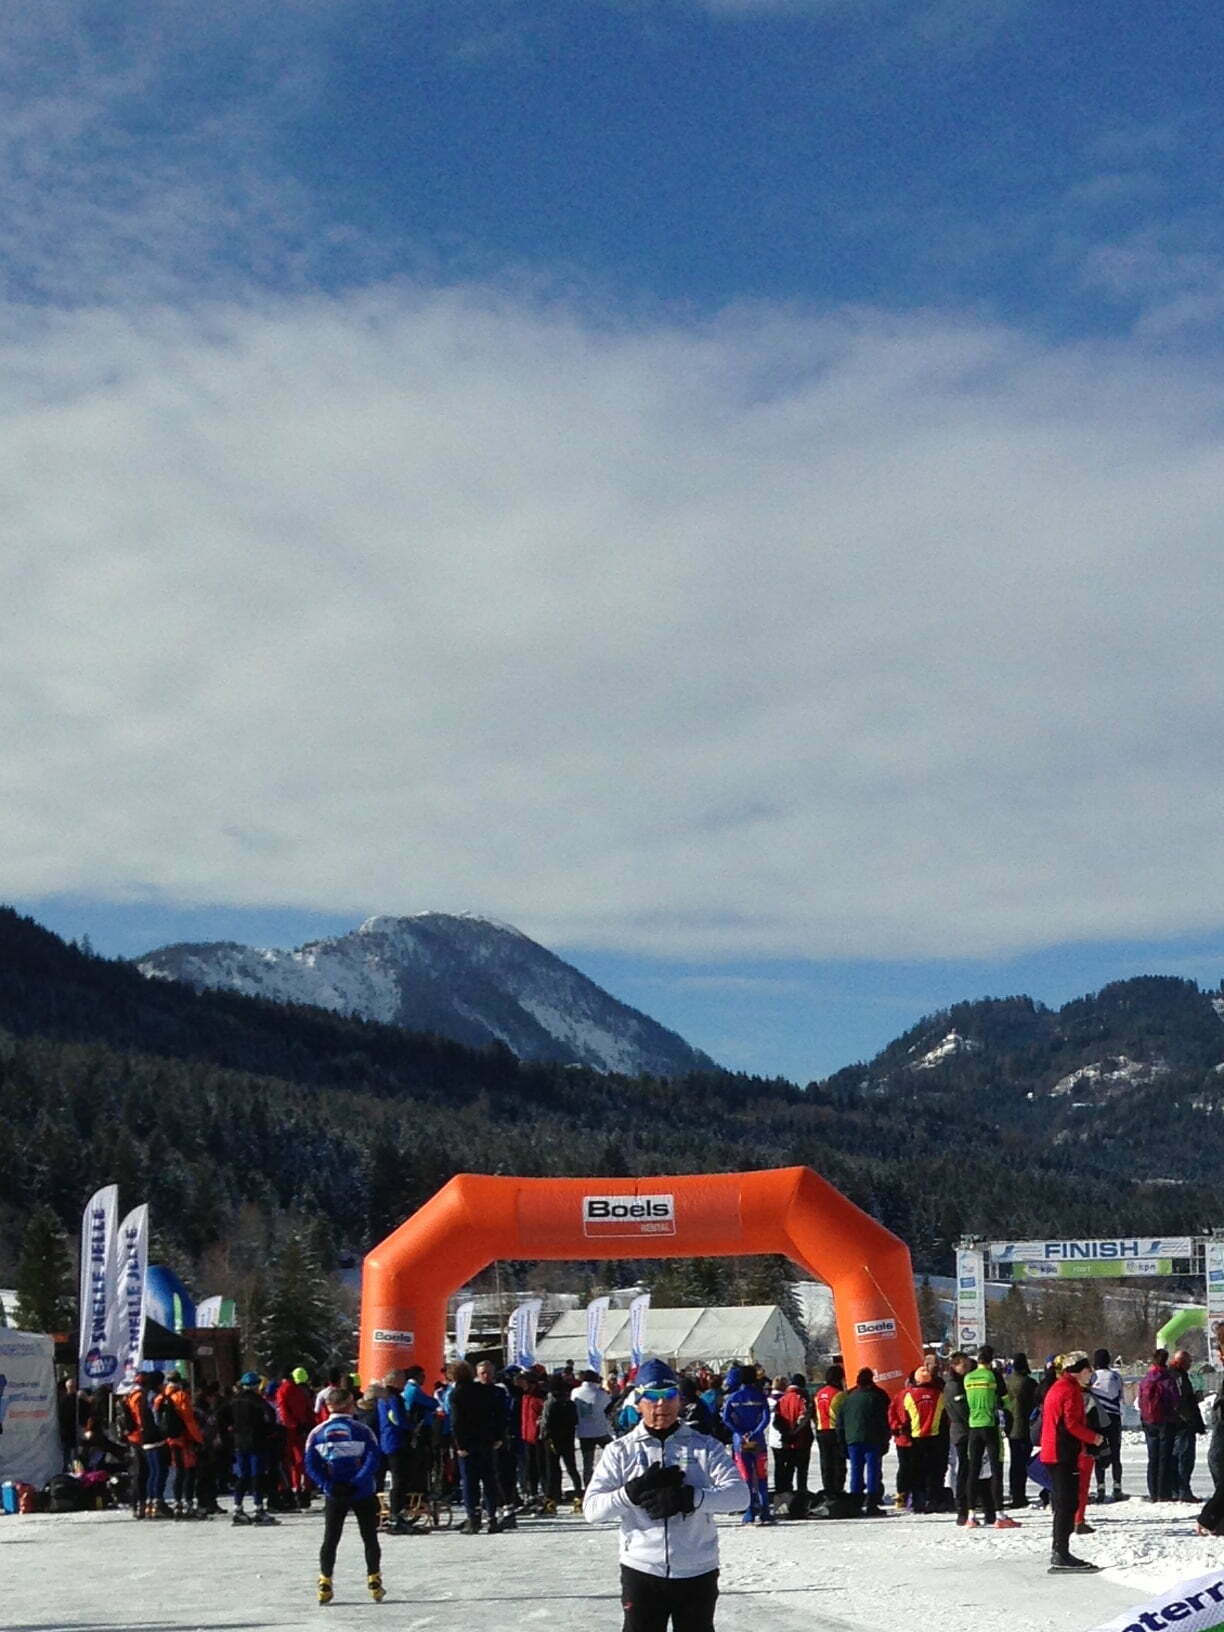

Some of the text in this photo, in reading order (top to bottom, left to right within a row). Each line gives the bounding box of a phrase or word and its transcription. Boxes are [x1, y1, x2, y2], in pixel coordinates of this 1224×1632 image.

[588, 1200, 669, 1217] Boels
[1045, 1241, 1138, 1259] FINISH
[92, 1271, 106, 1343] SNELLE
[857, 1321, 894, 1333] Boels
